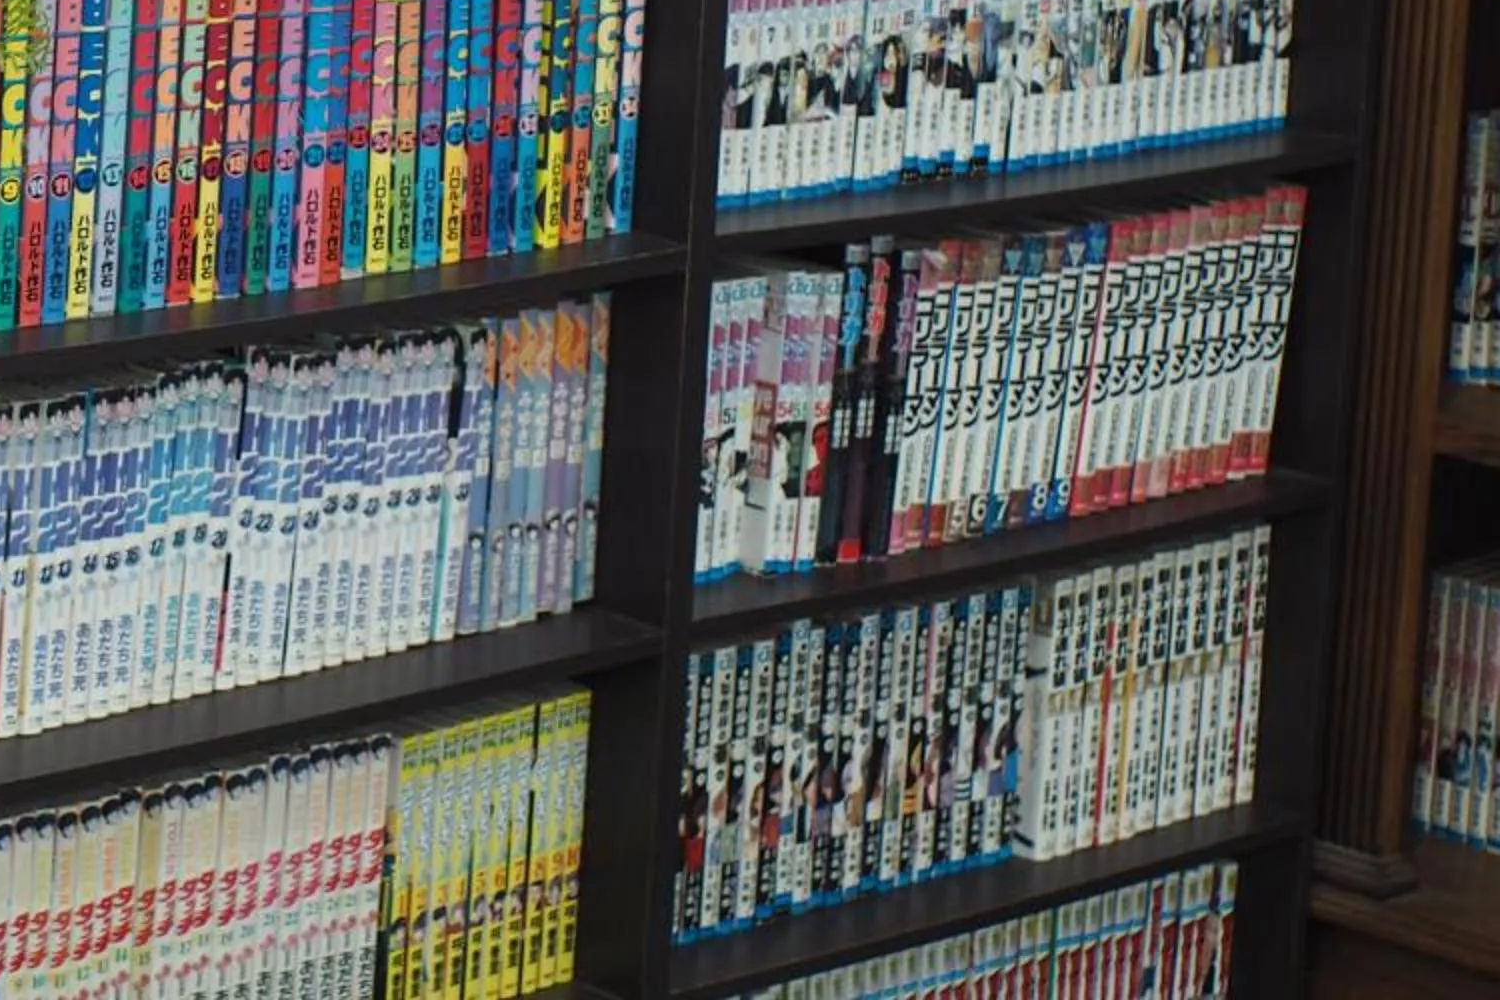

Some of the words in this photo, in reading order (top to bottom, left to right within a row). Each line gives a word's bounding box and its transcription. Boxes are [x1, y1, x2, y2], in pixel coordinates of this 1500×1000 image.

[4, 181, 19, 200] 9
[29, 177, 45, 196] 10
[54, 177, 69, 195] 11
